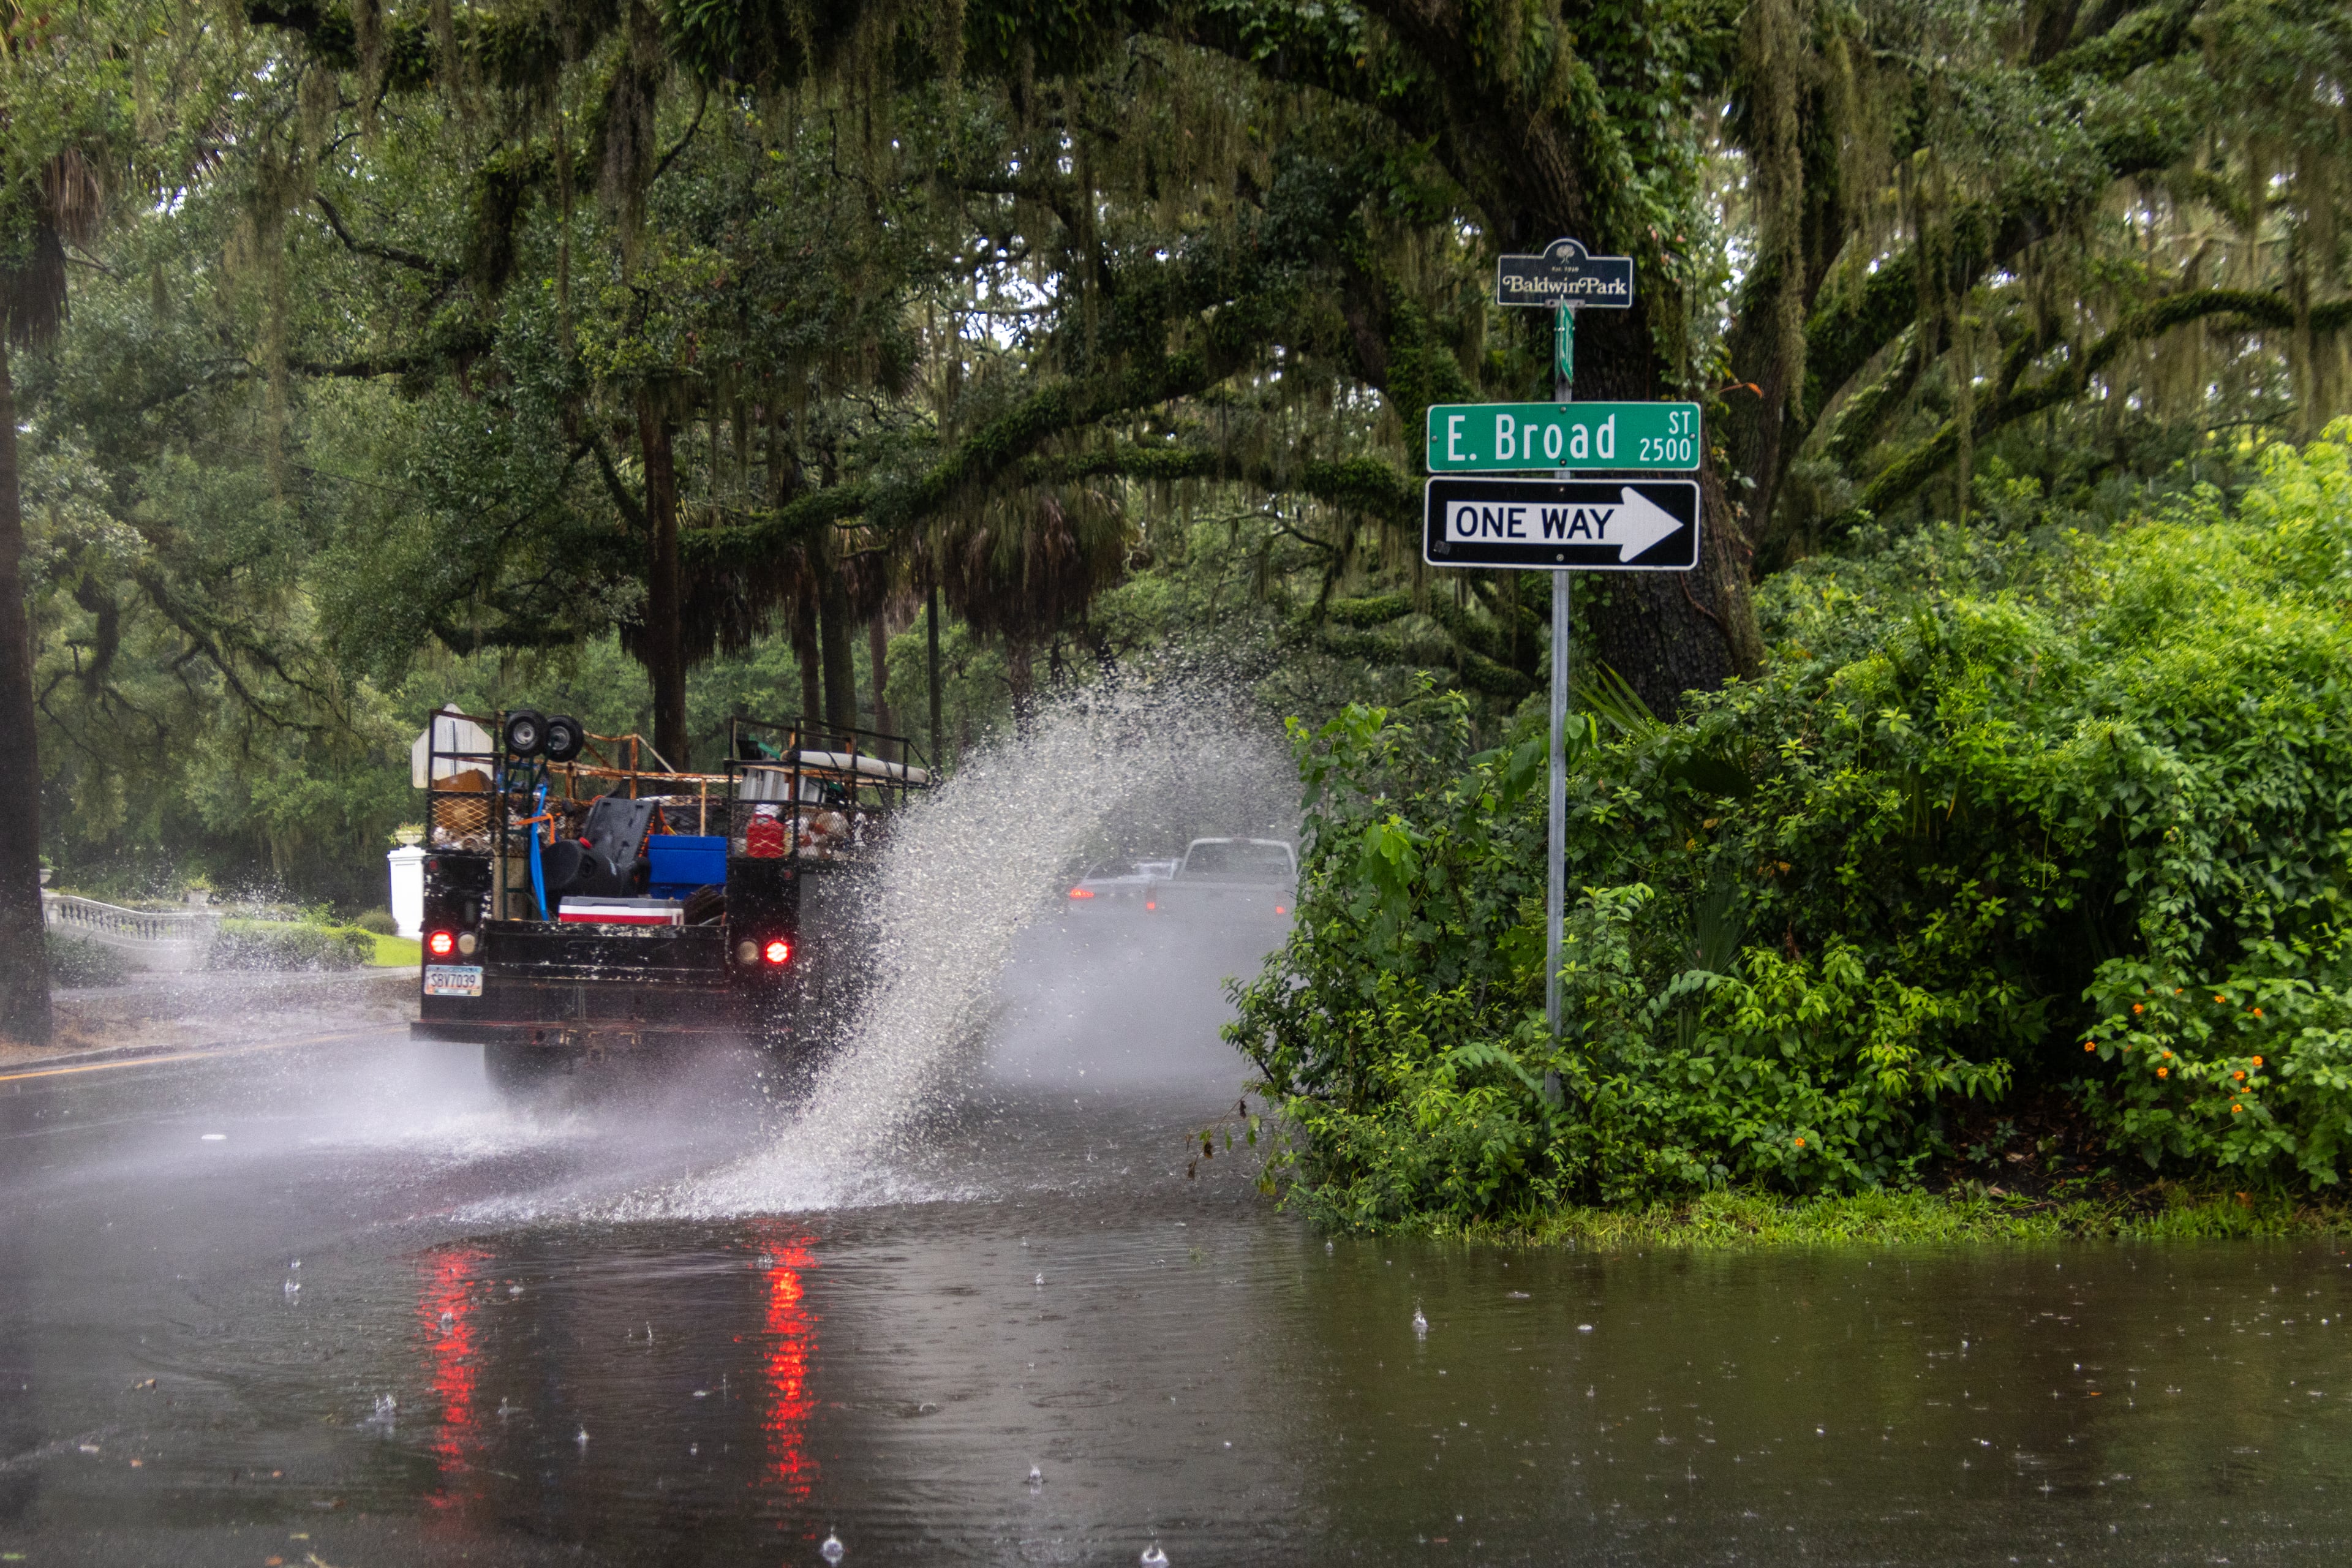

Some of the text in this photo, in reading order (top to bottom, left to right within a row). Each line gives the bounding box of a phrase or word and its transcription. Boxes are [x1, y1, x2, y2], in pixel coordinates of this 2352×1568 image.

[1502, 275, 1627, 295] Baldwin Park
[1668, 411, 1691, 435] ST
[1448, 413, 1615, 461] E. Broad
[1639, 437, 1691, 461] 2500
[1456, 506, 1615, 539] ONE WAY
[431, 973, 476, 987] SBV7039
